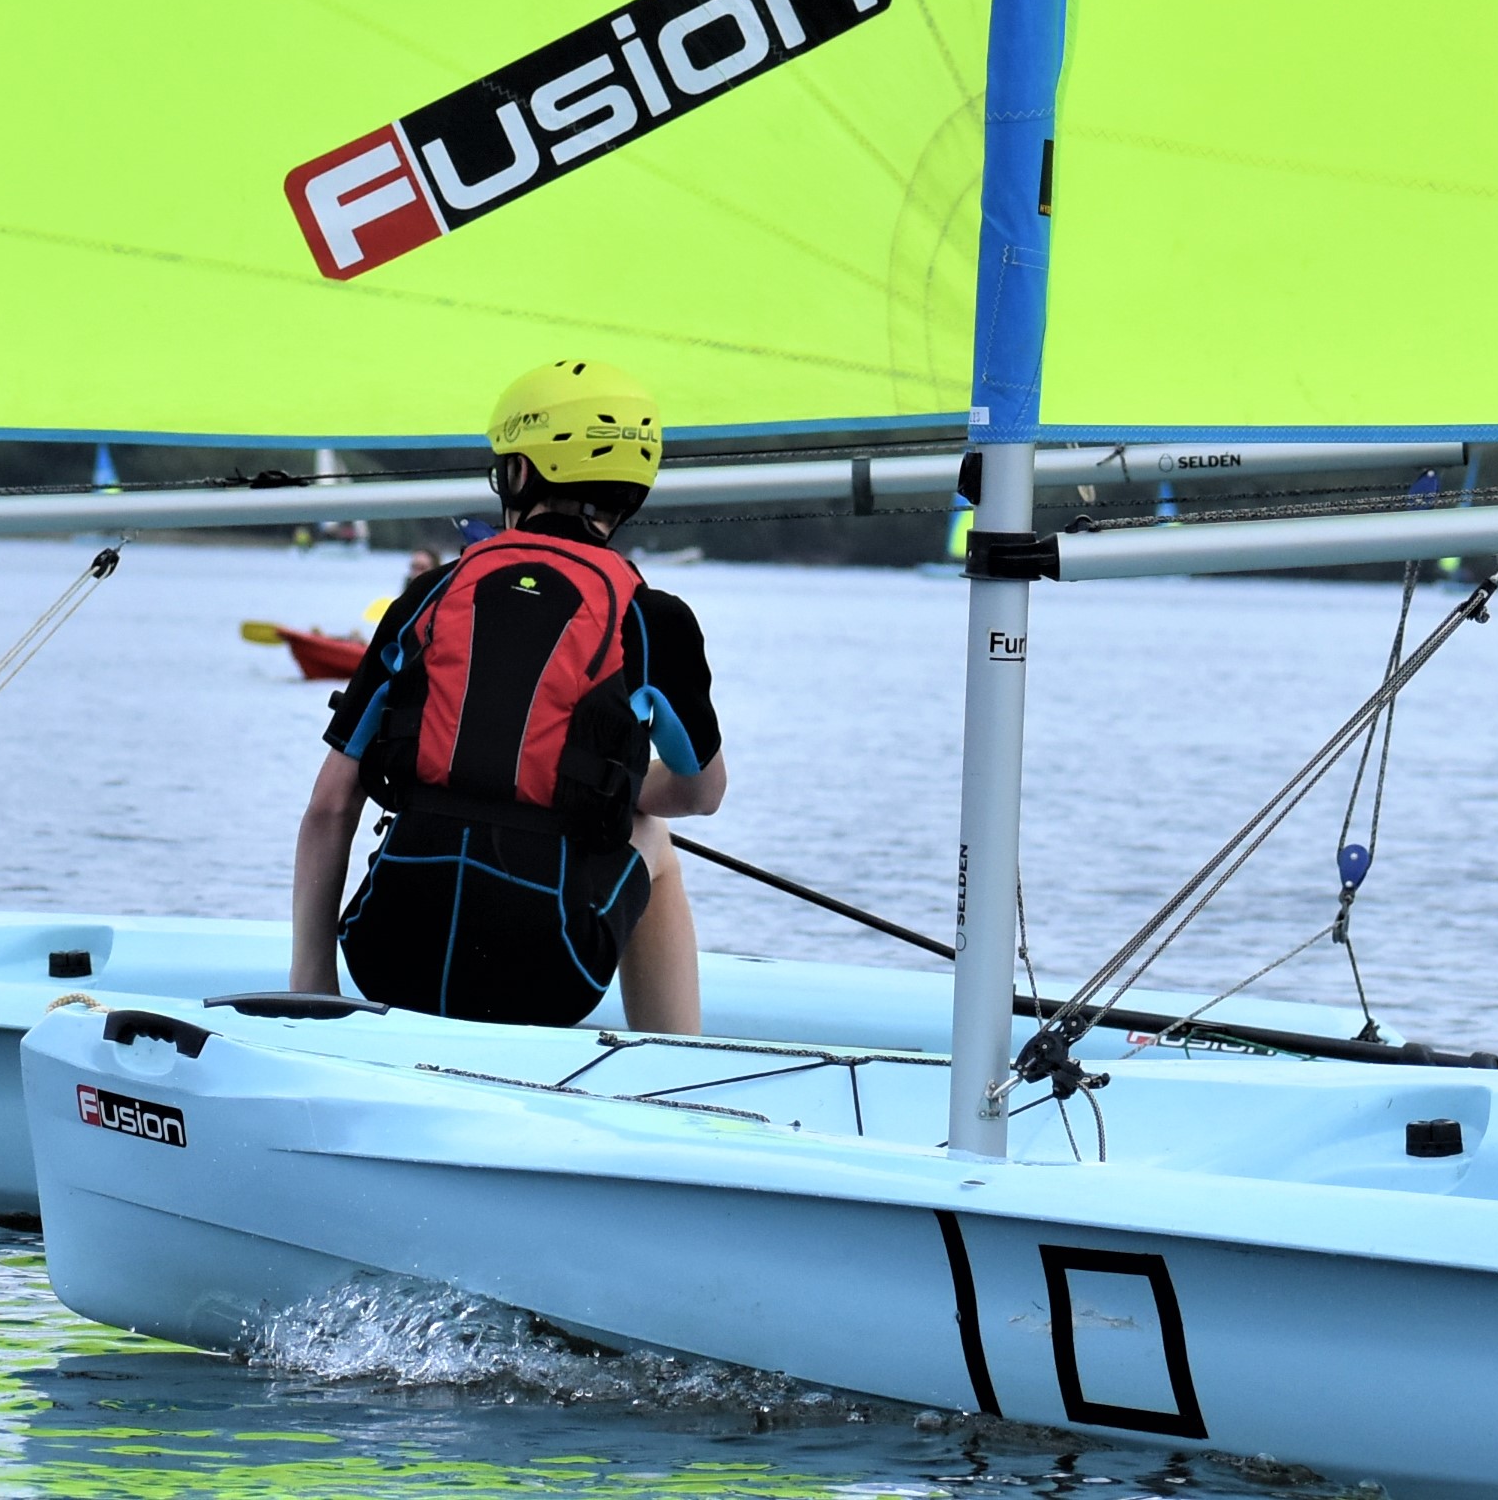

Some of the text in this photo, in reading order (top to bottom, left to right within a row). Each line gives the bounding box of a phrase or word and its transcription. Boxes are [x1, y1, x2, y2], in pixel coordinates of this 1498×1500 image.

[621, 426, 658, 443] GUL
[79, 1090, 184, 1145] Fusion
[932, 1208, 1210, 1440] 10
